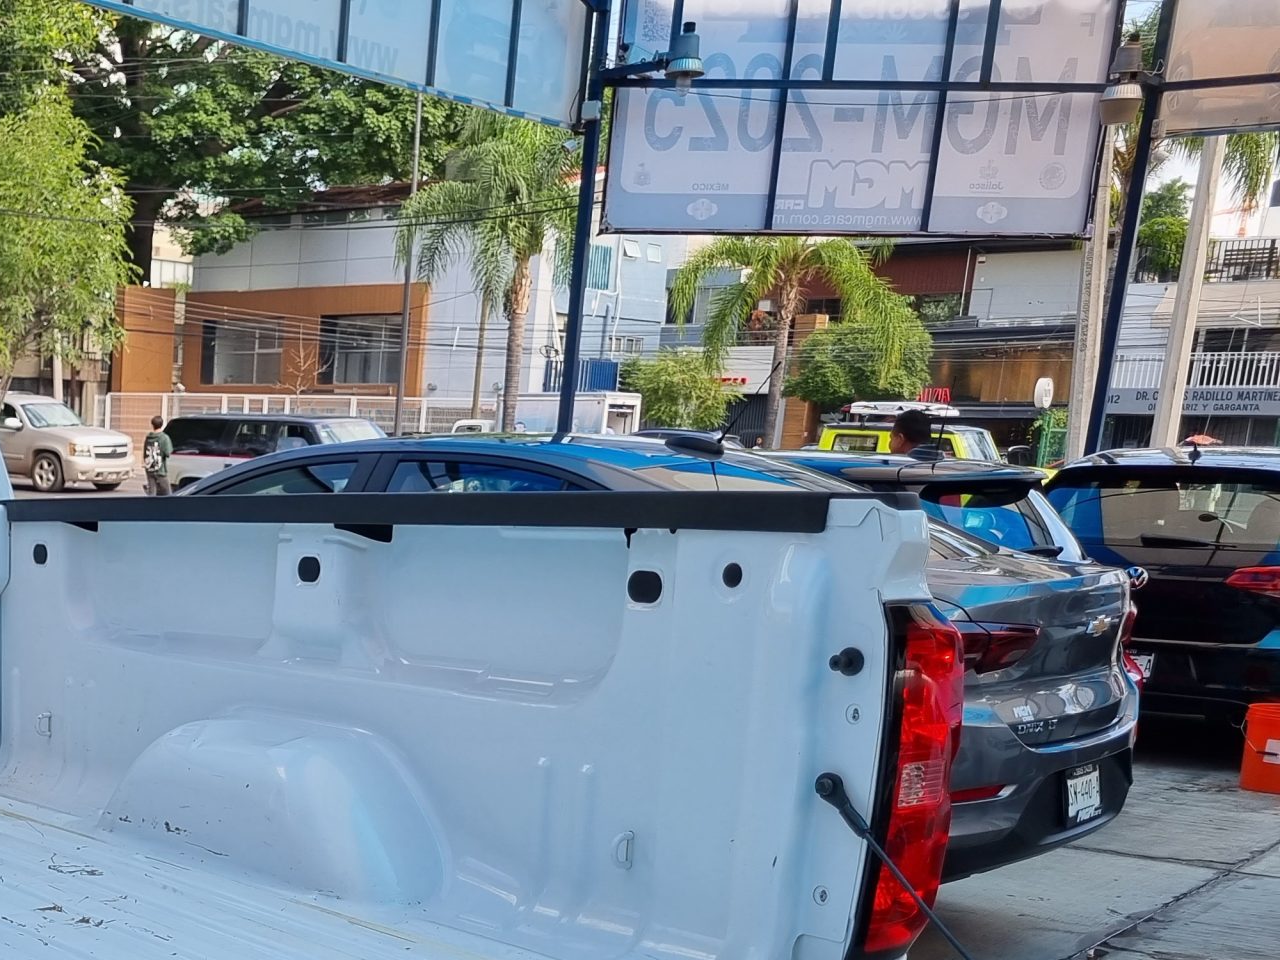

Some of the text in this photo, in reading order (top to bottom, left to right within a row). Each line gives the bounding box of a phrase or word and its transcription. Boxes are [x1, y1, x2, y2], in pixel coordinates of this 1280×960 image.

[1192, 391, 1233, 401] RADILLO
[1202, 403, 1209, 411] Y
[1213, 403, 1260, 411] GARGANTA
